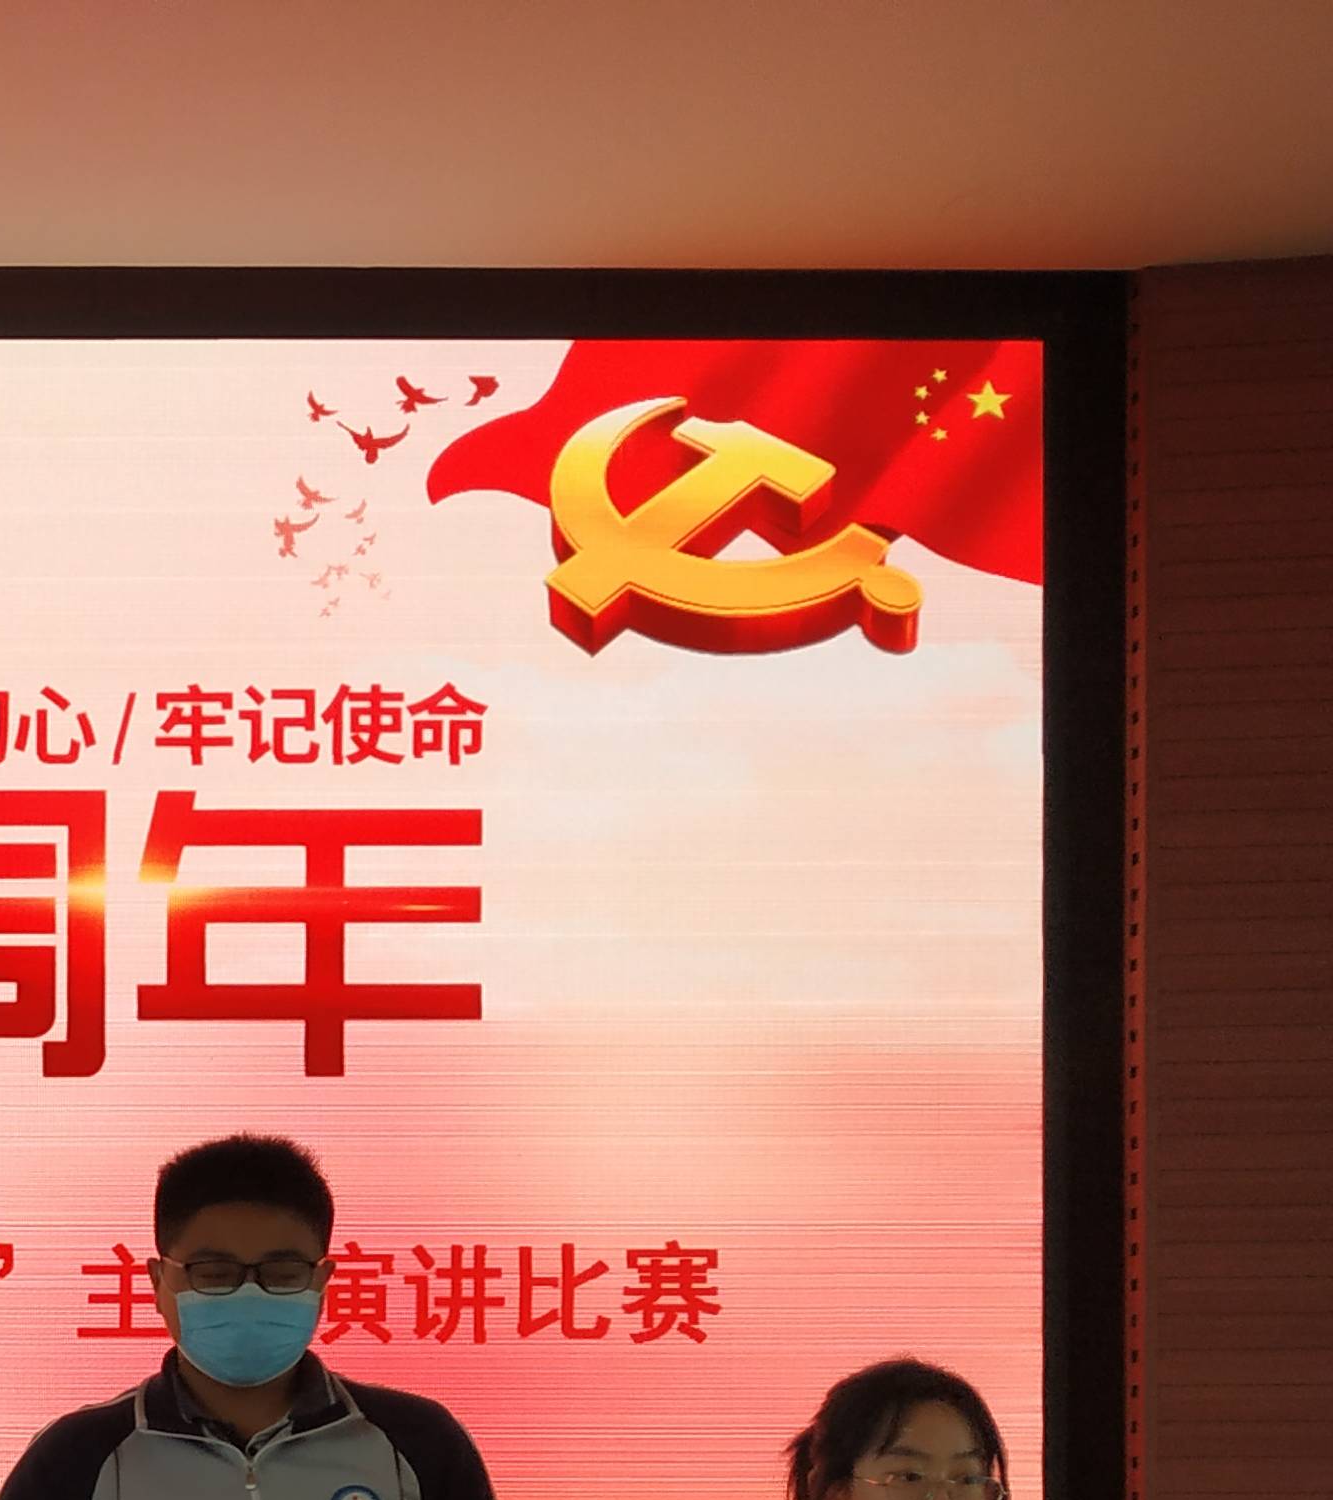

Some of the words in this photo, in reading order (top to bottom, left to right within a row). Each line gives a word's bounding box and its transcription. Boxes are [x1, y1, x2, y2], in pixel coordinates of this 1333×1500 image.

[77, 1241, 721, 1345] 主演讲比赛
